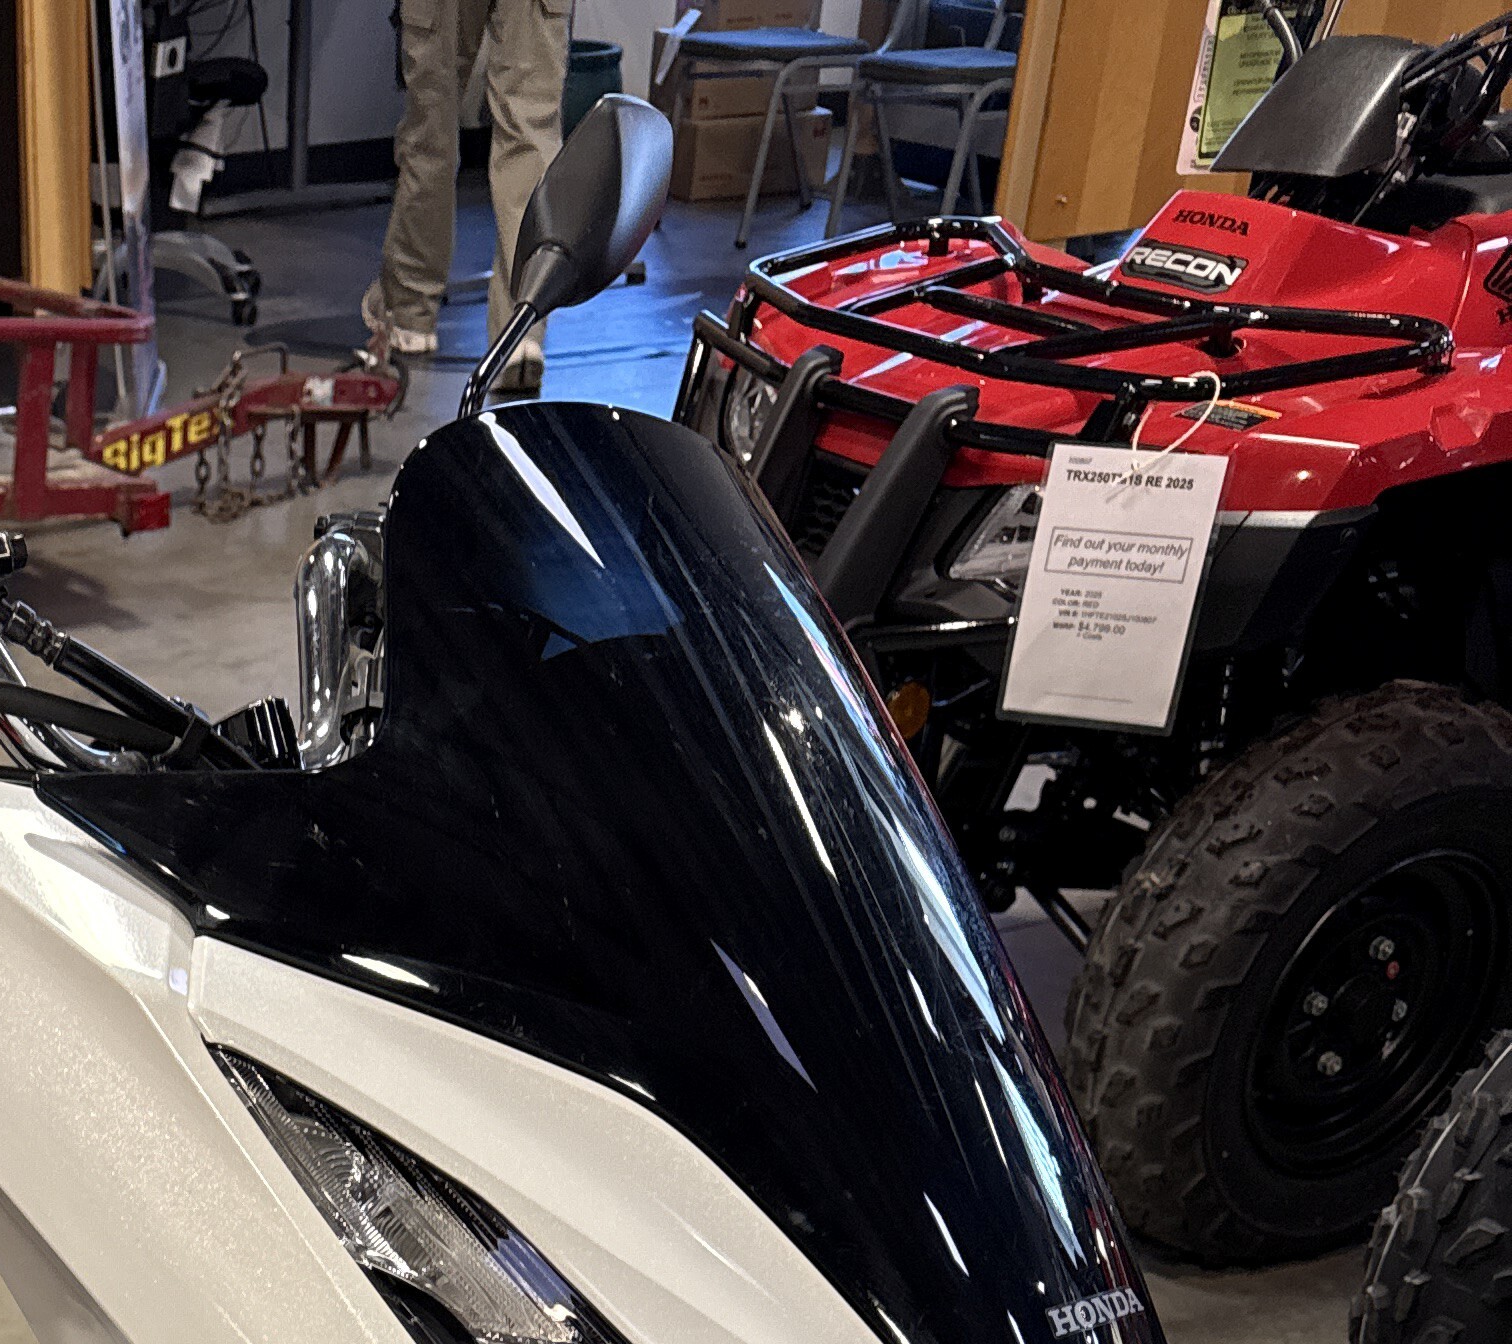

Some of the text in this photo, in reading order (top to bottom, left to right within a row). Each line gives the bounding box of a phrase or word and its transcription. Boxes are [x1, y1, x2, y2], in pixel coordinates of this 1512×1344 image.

[1173, 209, 1249, 236] HONDA
[1125, 246, 1243, 286] RECON
[1145, 476, 1164, 488] RE
[1165, 477, 1194, 490] 2025
[1053, 533, 1188, 560] Find out your monthly
[1067, 556, 1166, 576] payment today!
[1048, 1287, 1145, 1337] HONDA
